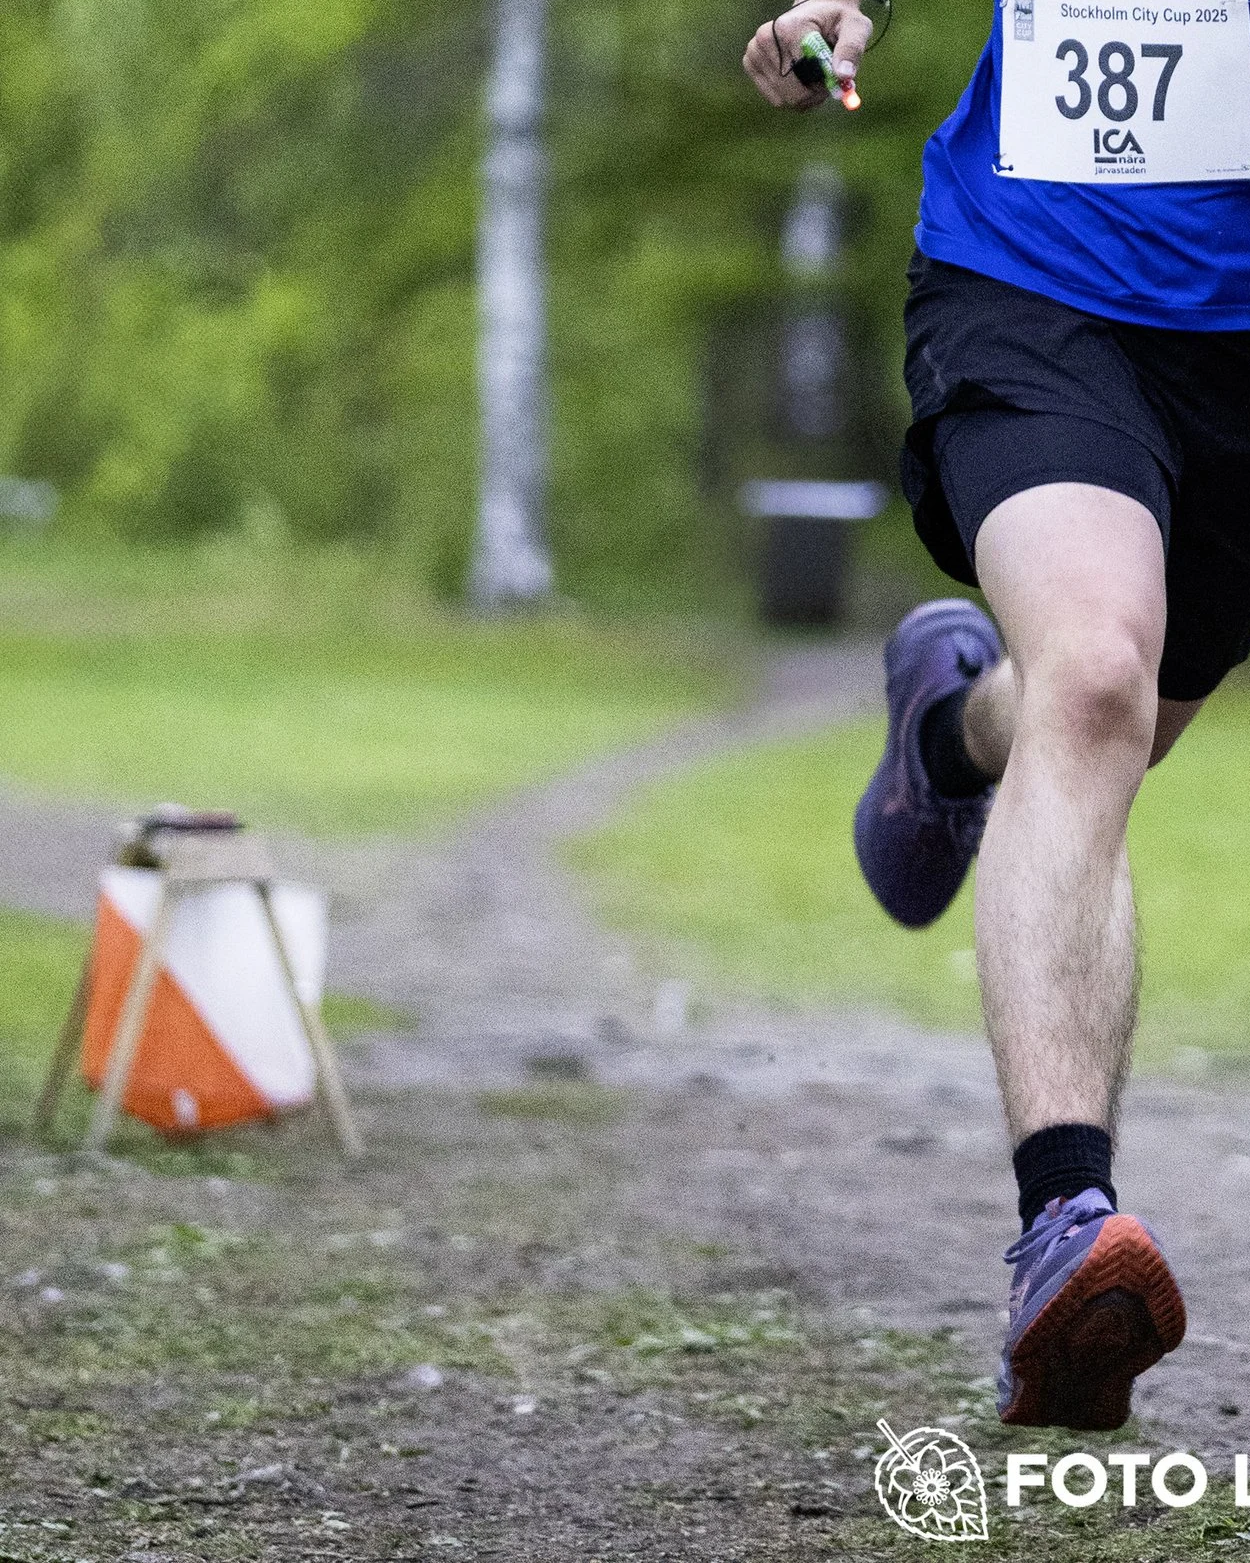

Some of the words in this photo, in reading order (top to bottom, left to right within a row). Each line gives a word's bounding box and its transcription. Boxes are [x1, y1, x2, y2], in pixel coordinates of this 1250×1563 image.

[1060, 3, 1128, 21] Stockholm
[1132, 7, 1159, 26] City
[1163, 8, 1191, 26] Cup
[1195, 8, 1228, 23] 2025
[1055, 39, 1183, 122] 387
[1093, 128, 1144, 154] ICA
[1118, 155, 1146, 164] nära
